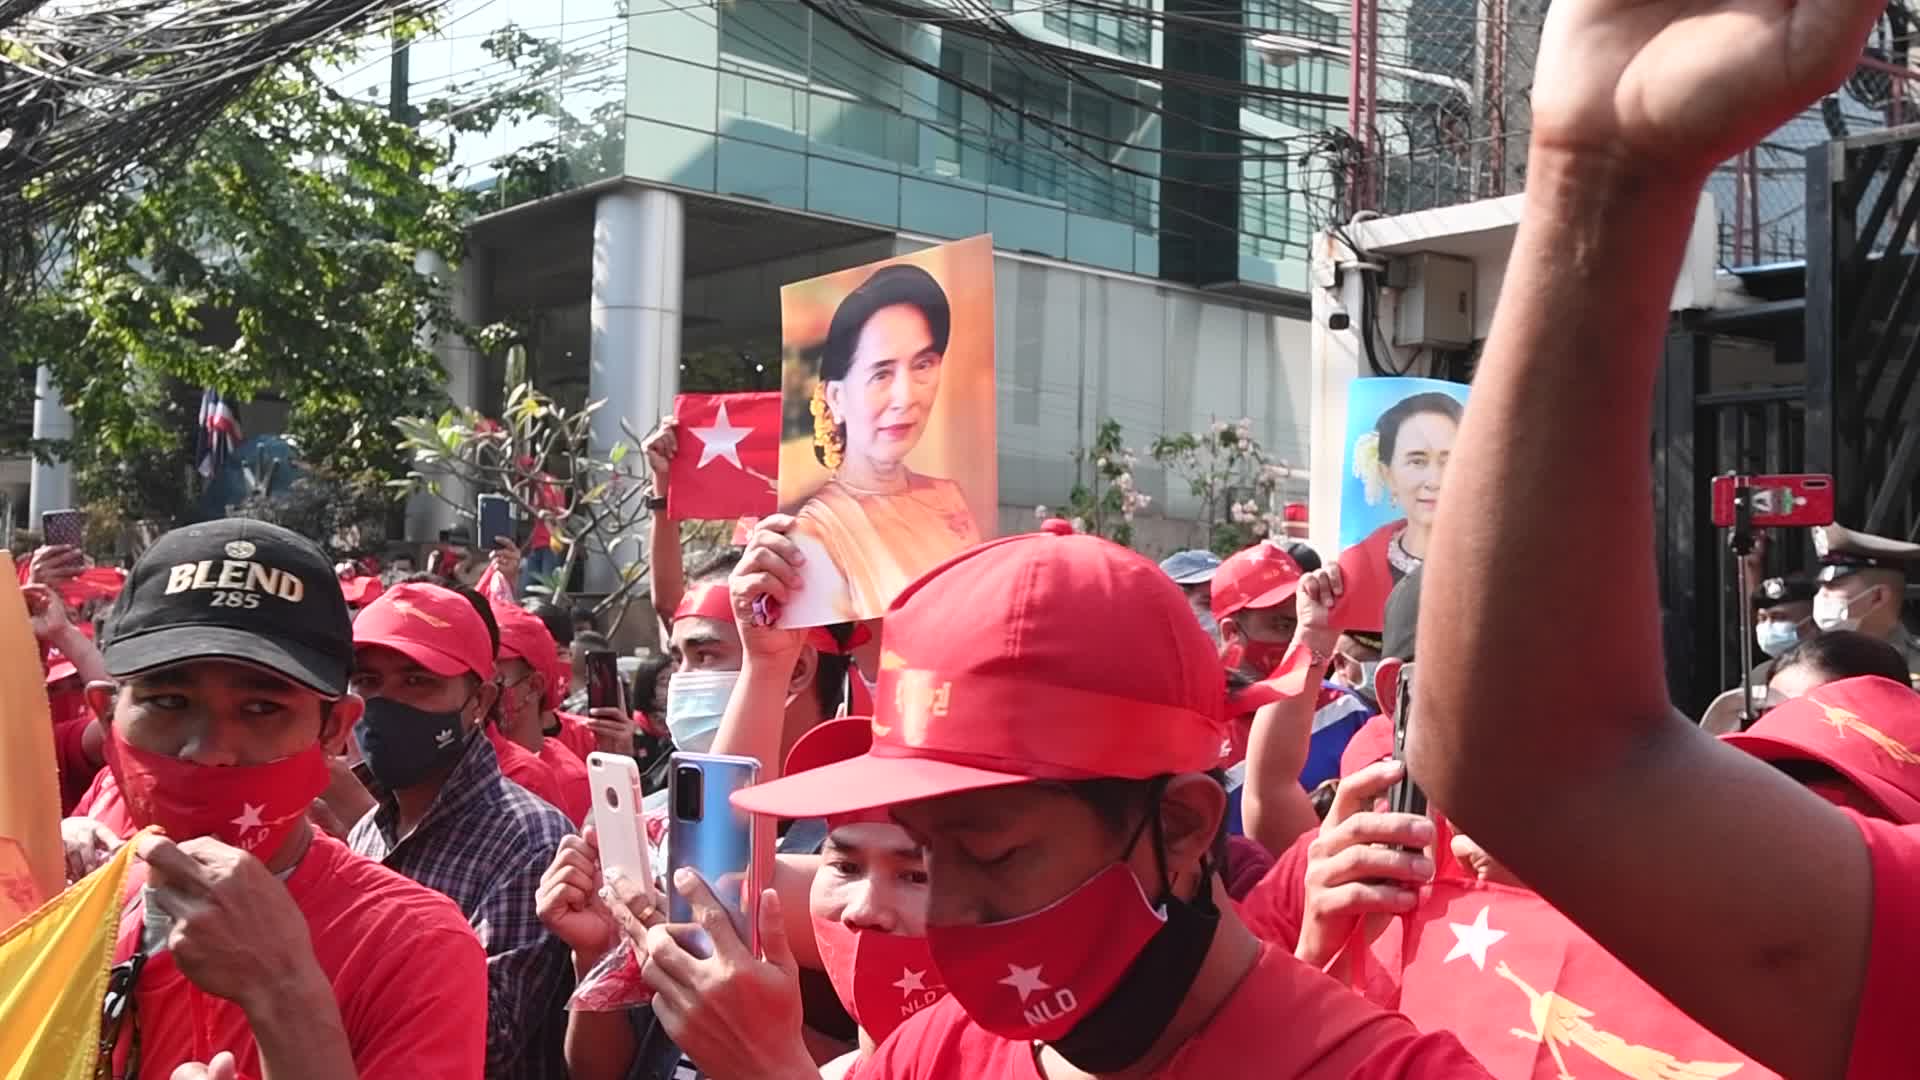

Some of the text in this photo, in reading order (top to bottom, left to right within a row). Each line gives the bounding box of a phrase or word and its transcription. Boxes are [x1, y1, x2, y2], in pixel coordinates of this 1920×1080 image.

[165, 560, 304, 602] BLEND
[209, 591, 261, 609] 285
[900, 990, 937, 1017] NLD
[1023, 988, 1078, 1027] NLD
